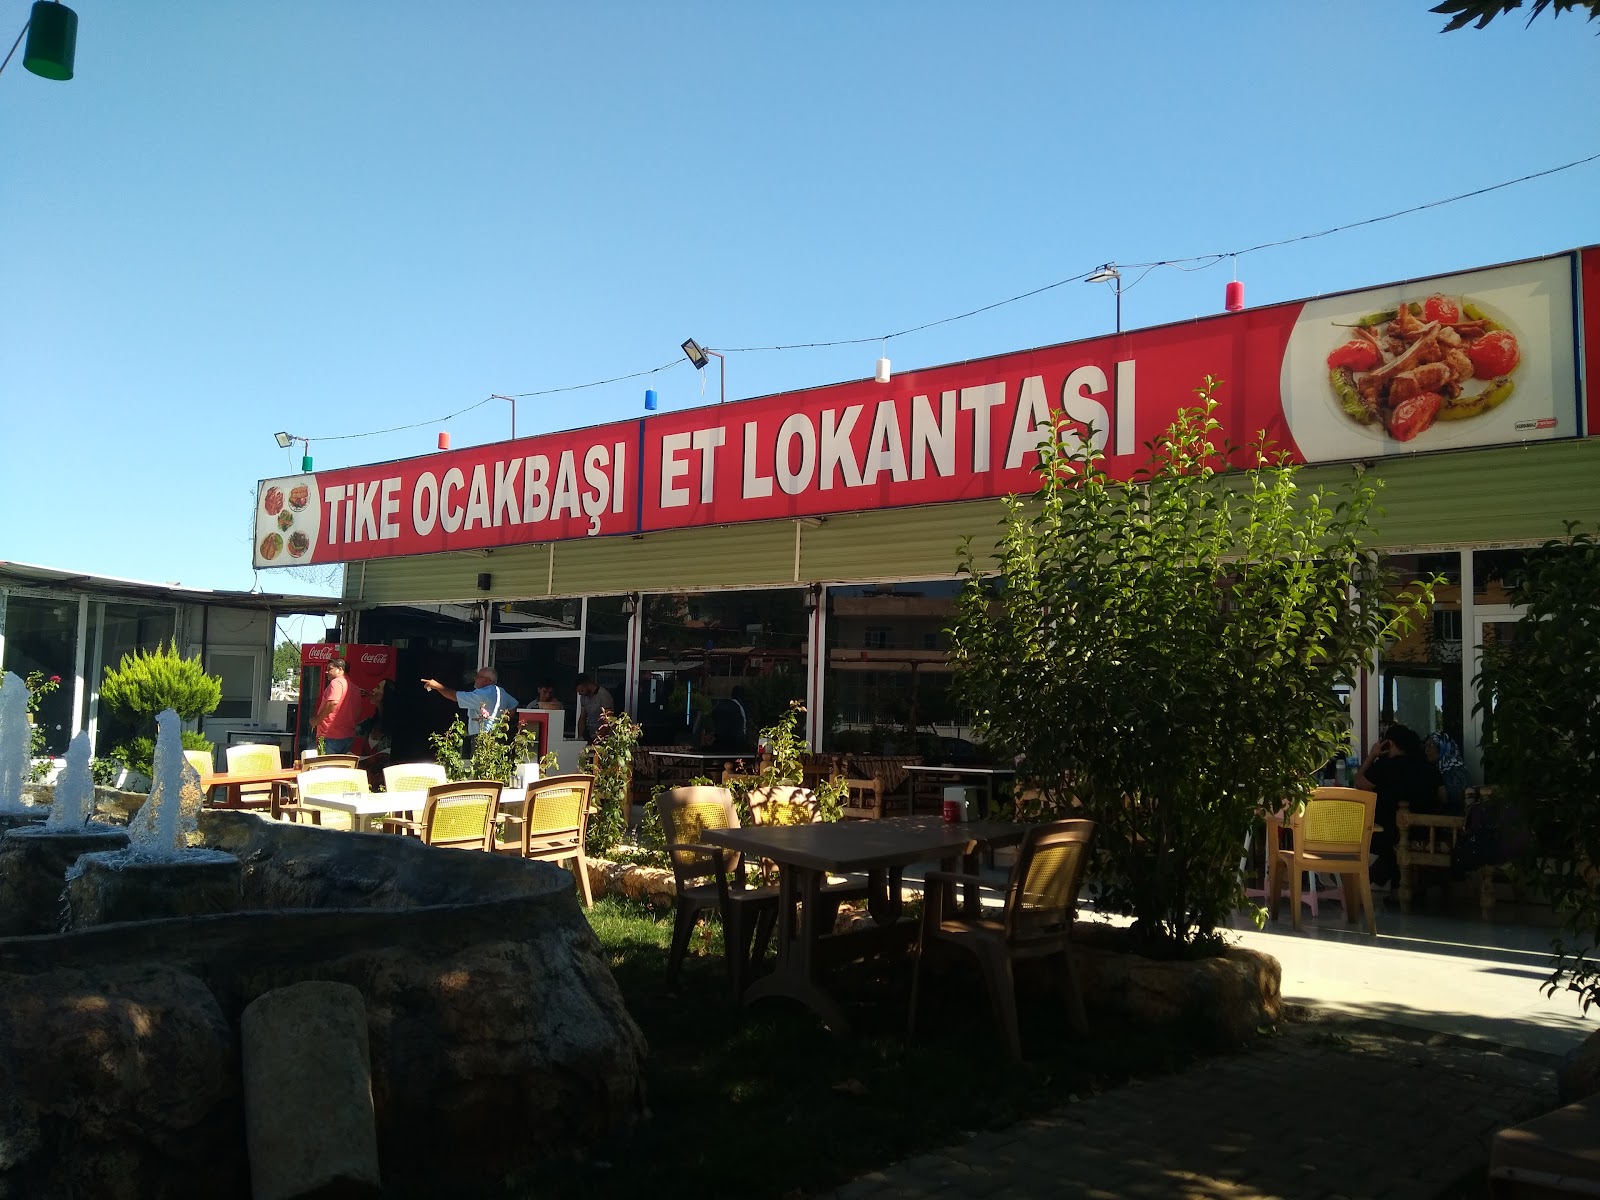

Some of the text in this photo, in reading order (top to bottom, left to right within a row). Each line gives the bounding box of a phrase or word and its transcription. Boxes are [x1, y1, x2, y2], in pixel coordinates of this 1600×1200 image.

[412, 442, 626, 536] OCAKBAŞI
[660, 426, 726, 509] ET
[742, 359, 1136, 500] LOKANTASI
